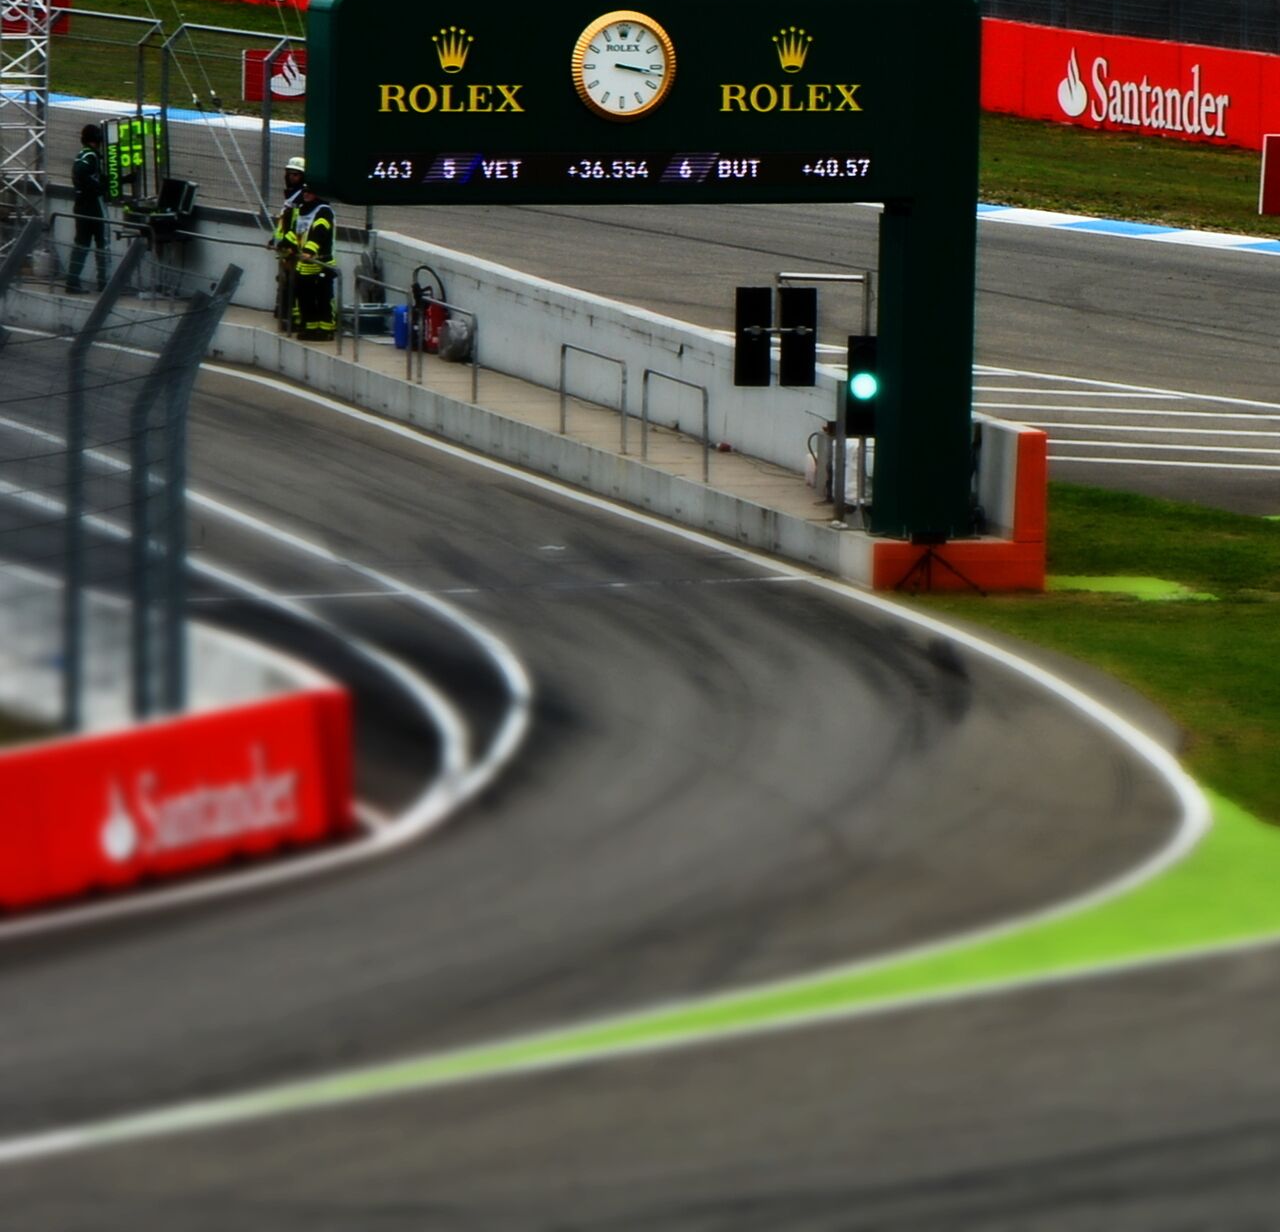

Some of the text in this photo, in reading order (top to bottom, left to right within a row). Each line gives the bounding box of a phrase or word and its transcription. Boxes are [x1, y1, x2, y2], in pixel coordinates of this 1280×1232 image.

[606, 44, 640, 52] ROLEX
[378, 83, 525, 113] ROLEX
[719, 83, 863, 113] ROLEX
[1090, 57, 1229, 137] Santander
[443, 159, 456, 179] 5
[481, 160, 521, 179] VET
[567, 161, 649, 179] +36.554
[680, 159, 692, 179] 6
[718, 160, 760, 178] BUT
[802, 159, 870, 178] +40.57
[137, 741, 298, 856] Santander
